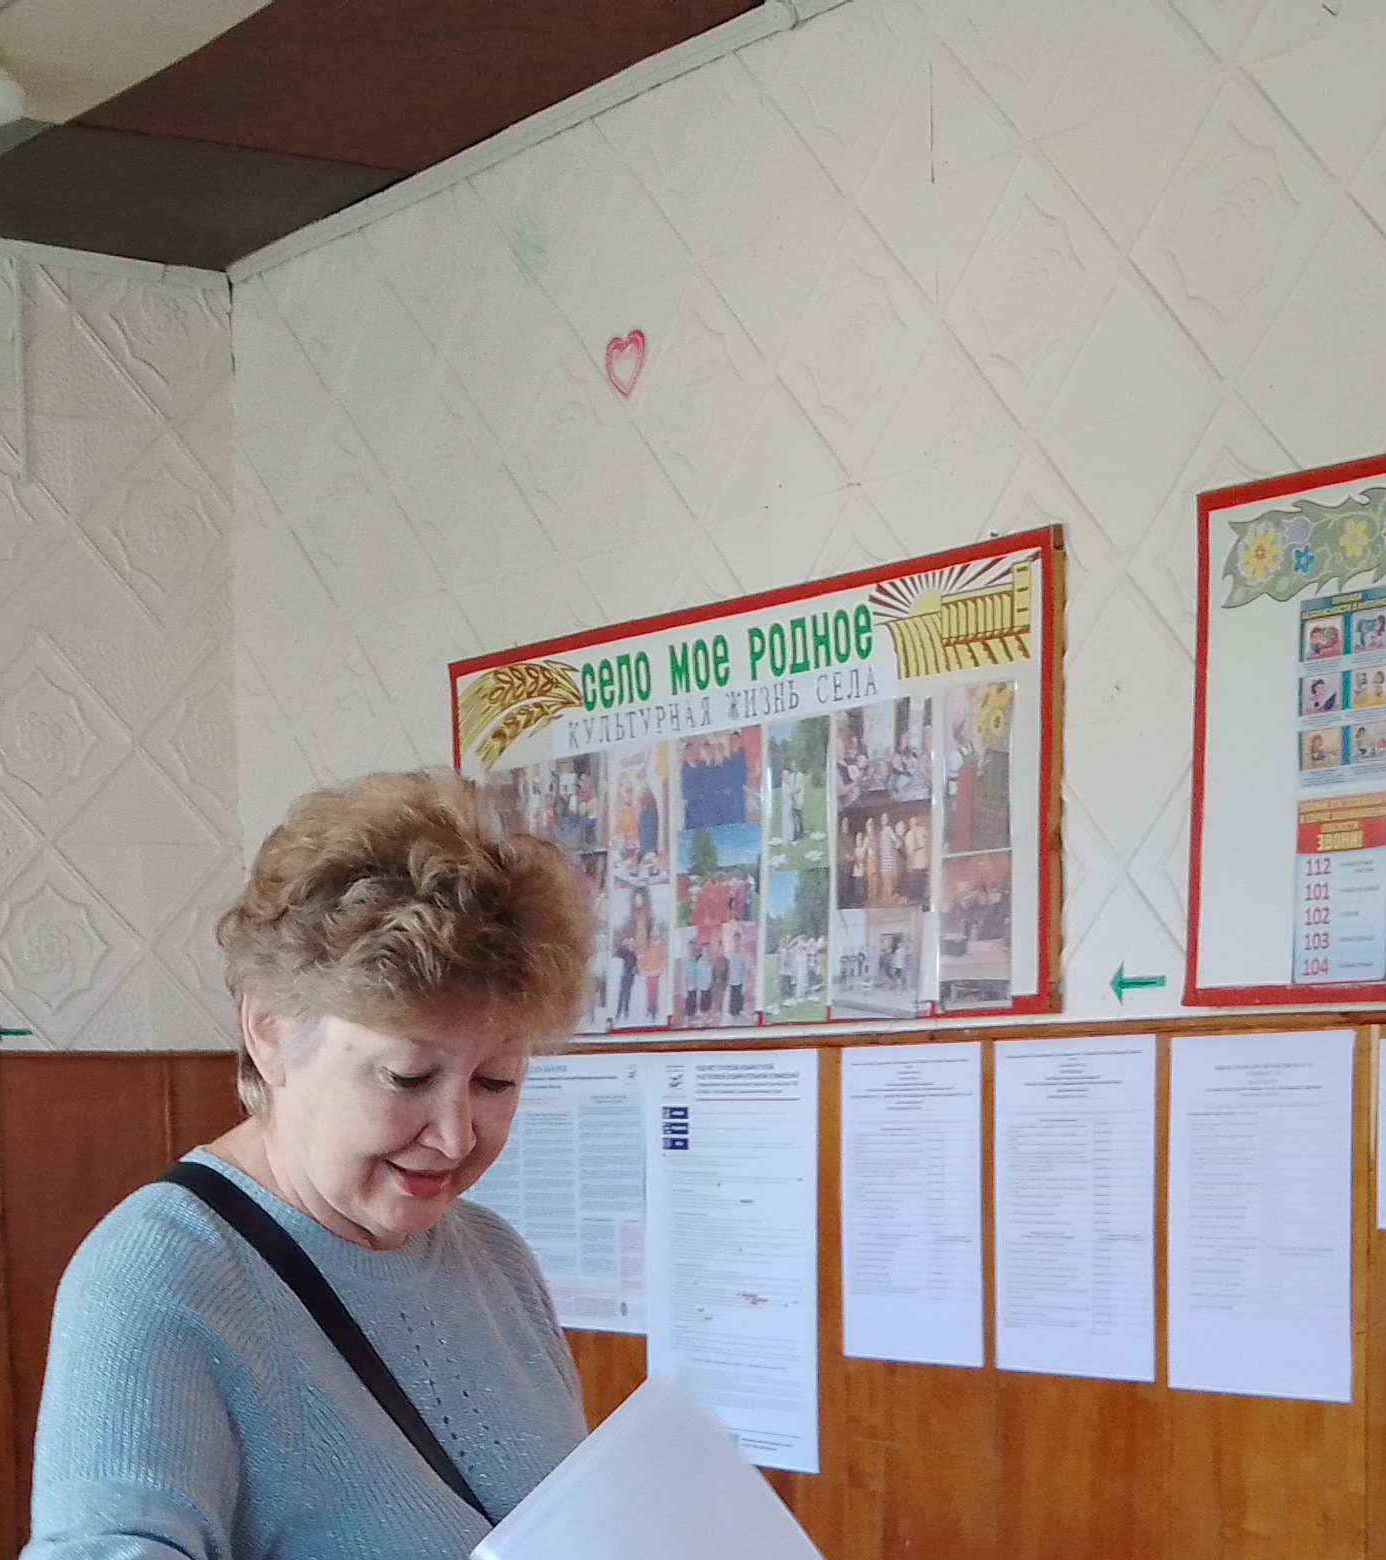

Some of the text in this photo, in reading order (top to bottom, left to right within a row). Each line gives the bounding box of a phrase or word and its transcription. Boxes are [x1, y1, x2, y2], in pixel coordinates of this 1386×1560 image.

[568, 665, 879, 750] КУЛЬТУРНАЯ ЖИЗНЬ СЕЛА
[1306, 857, 1331, 876] 112
[1305, 882, 1330, 901] 101
[1305, 907, 1330, 925] 102
[1305, 932, 1330, 951] 103
[1303, 957, 1329, 976] 104
